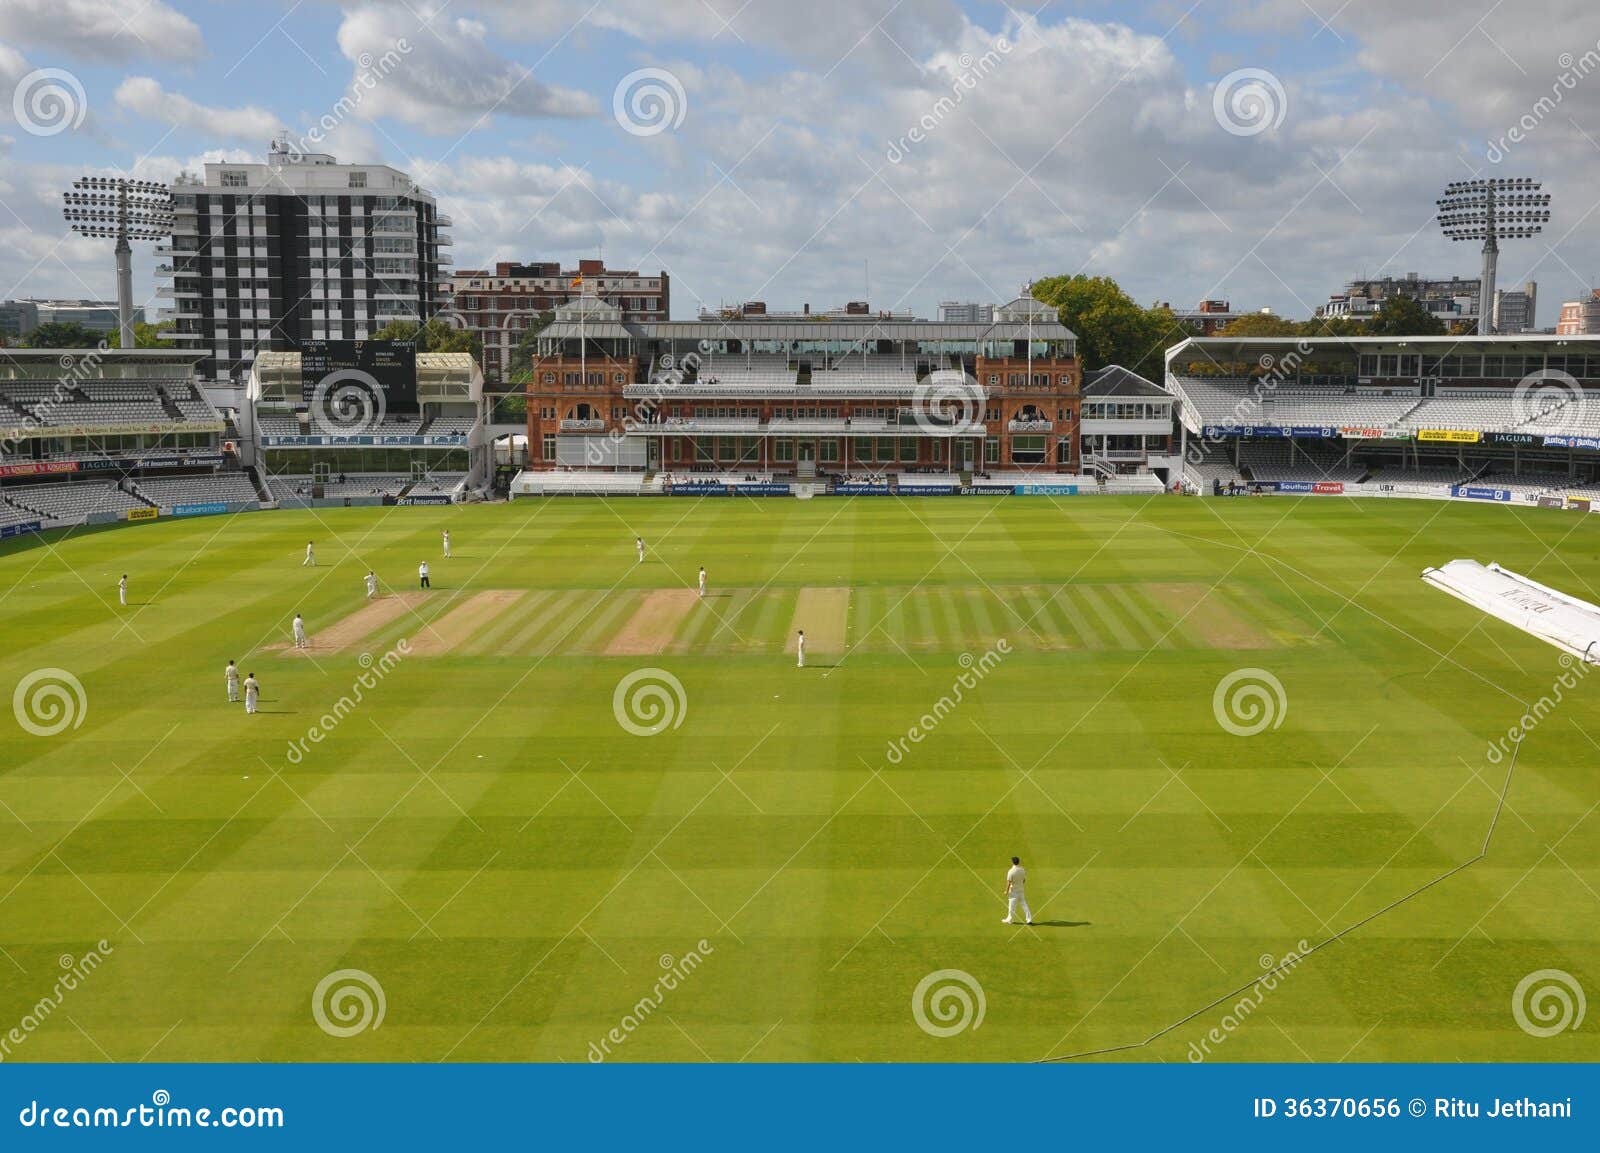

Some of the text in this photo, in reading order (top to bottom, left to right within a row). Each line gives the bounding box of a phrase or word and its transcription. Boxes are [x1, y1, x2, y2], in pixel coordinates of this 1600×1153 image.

[354, 341, 363, 349] 37
[1361, 428, 1382, 437] HERO
[1495, 434, 1533, 443] JAGUAR
[82, 461, 120, 469] JAGUAR
[960, 486, 1011, 495] Brit Insurance
[1032, 485, 1070, 495] Lebara
[1280, 482, 1313, 491] Southall
[1315, 483, 1342, 492] Travel
[396, 496, 447, 506] Brit Insurance
